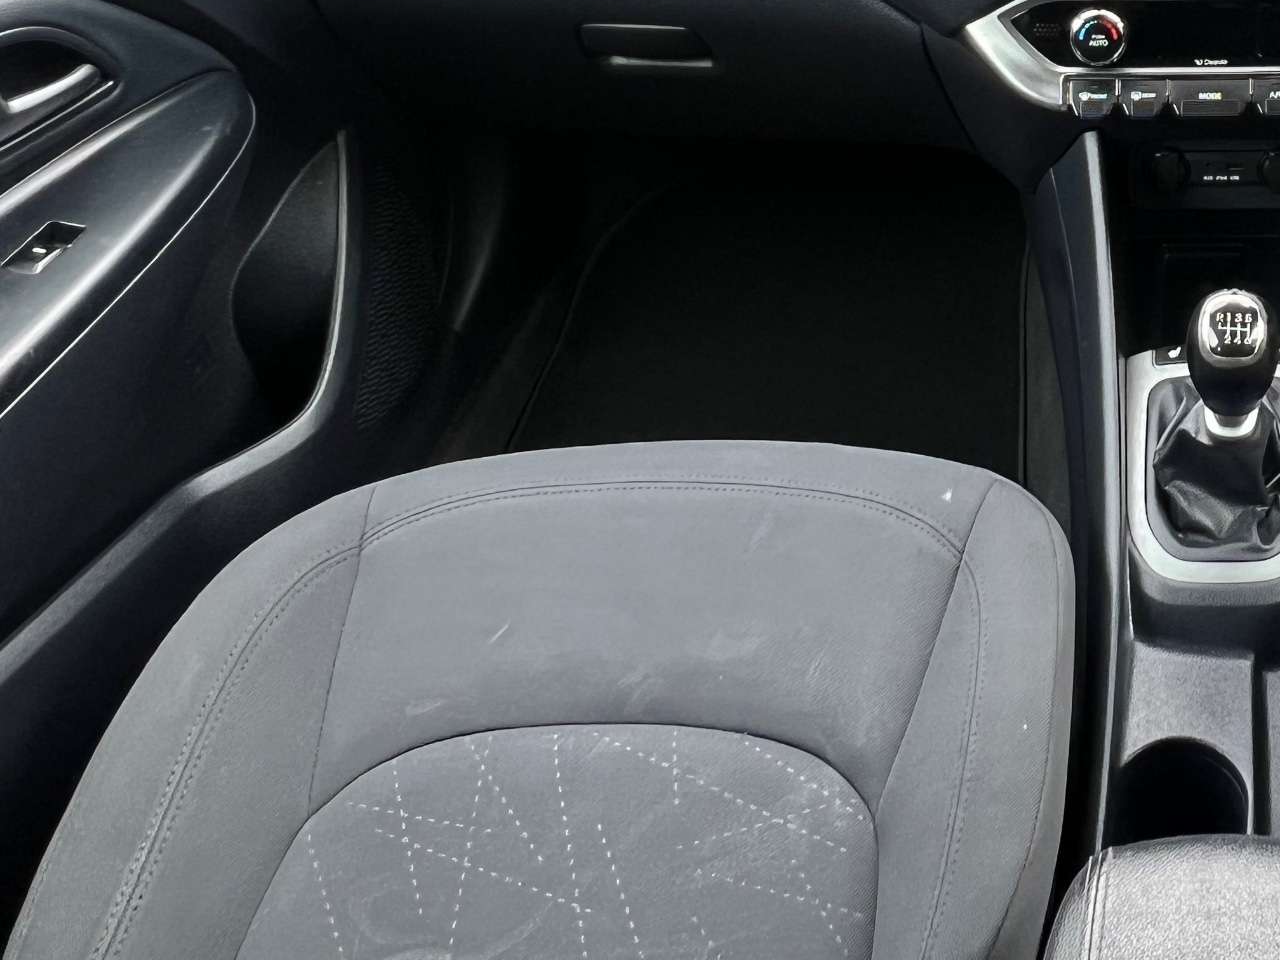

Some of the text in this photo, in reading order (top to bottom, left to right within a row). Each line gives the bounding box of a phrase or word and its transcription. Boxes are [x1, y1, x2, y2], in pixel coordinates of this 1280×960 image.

[1089, 39, 1109, 47] AUTO
[1216, 312, 1224, 323] R
[1234, 312, 1243, 323] 3
[1244, 313, 1253, 323] 5
